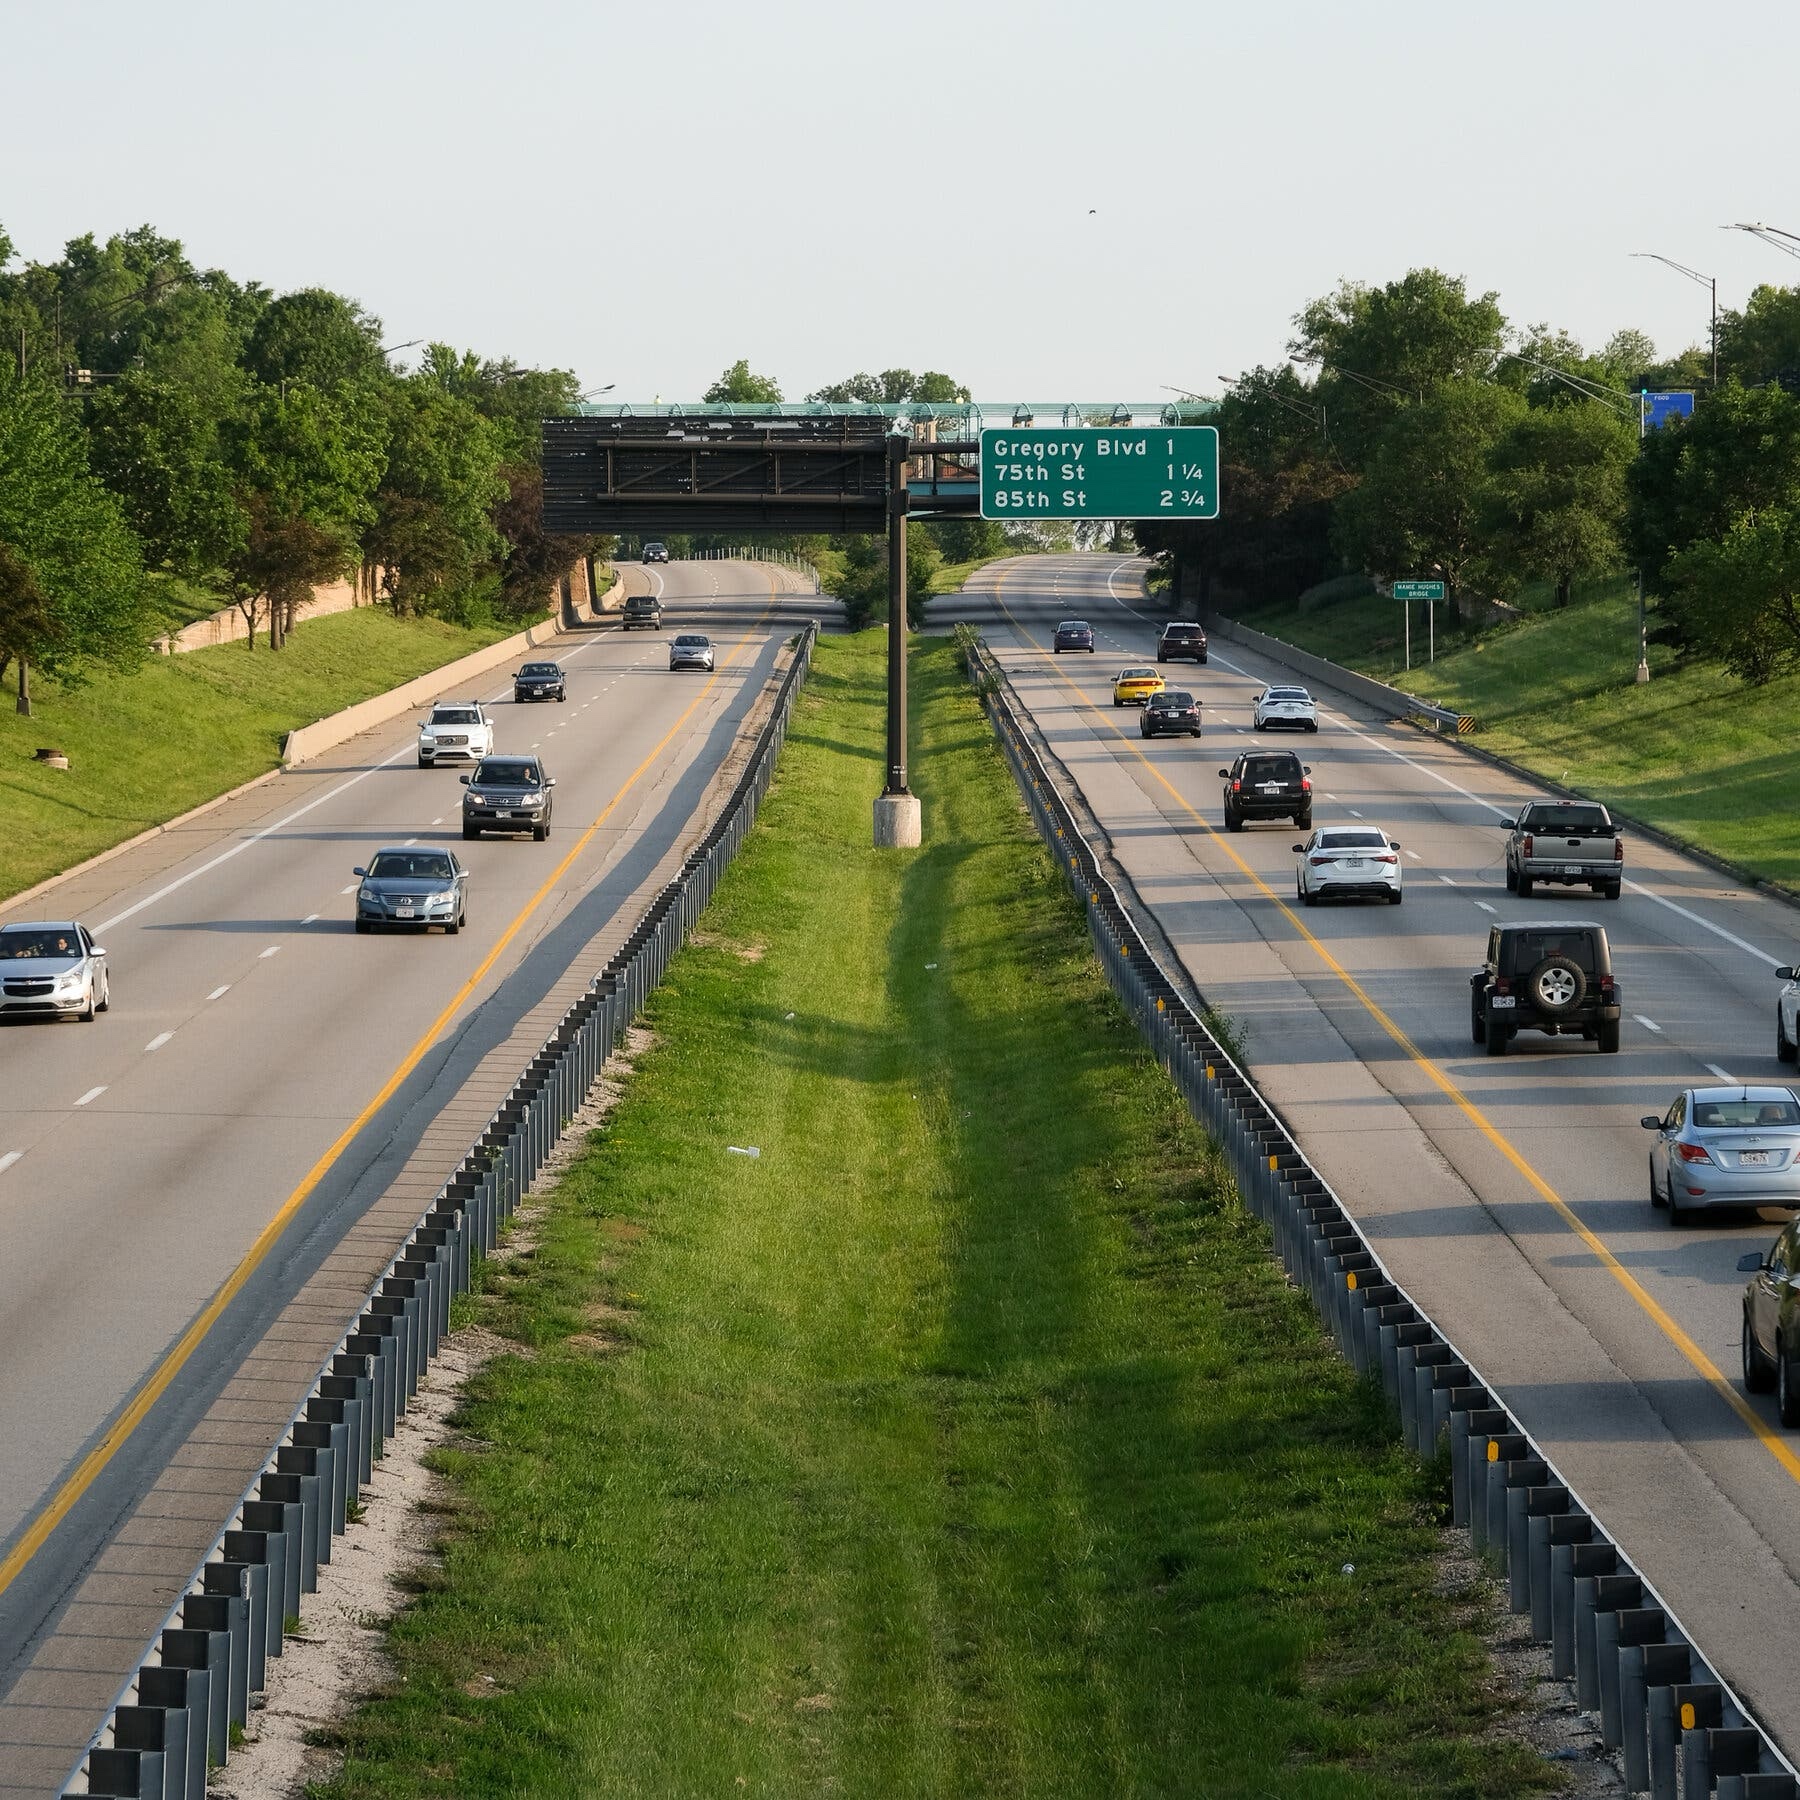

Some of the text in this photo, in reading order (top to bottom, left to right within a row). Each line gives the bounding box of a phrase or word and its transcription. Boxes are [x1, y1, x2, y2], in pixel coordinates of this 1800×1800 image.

[995, 439, 1173, 461] Gregory Blvd 1
[995, 465, 1049, 481] 75th
[1062, 464, 1085, 481] St
[1167, 464, 1173, 480] 1
[995, 491, 1050, 507] 85th
[1063, 491, 1086, 507] St
[1160, 491, 1173, 507] 2
